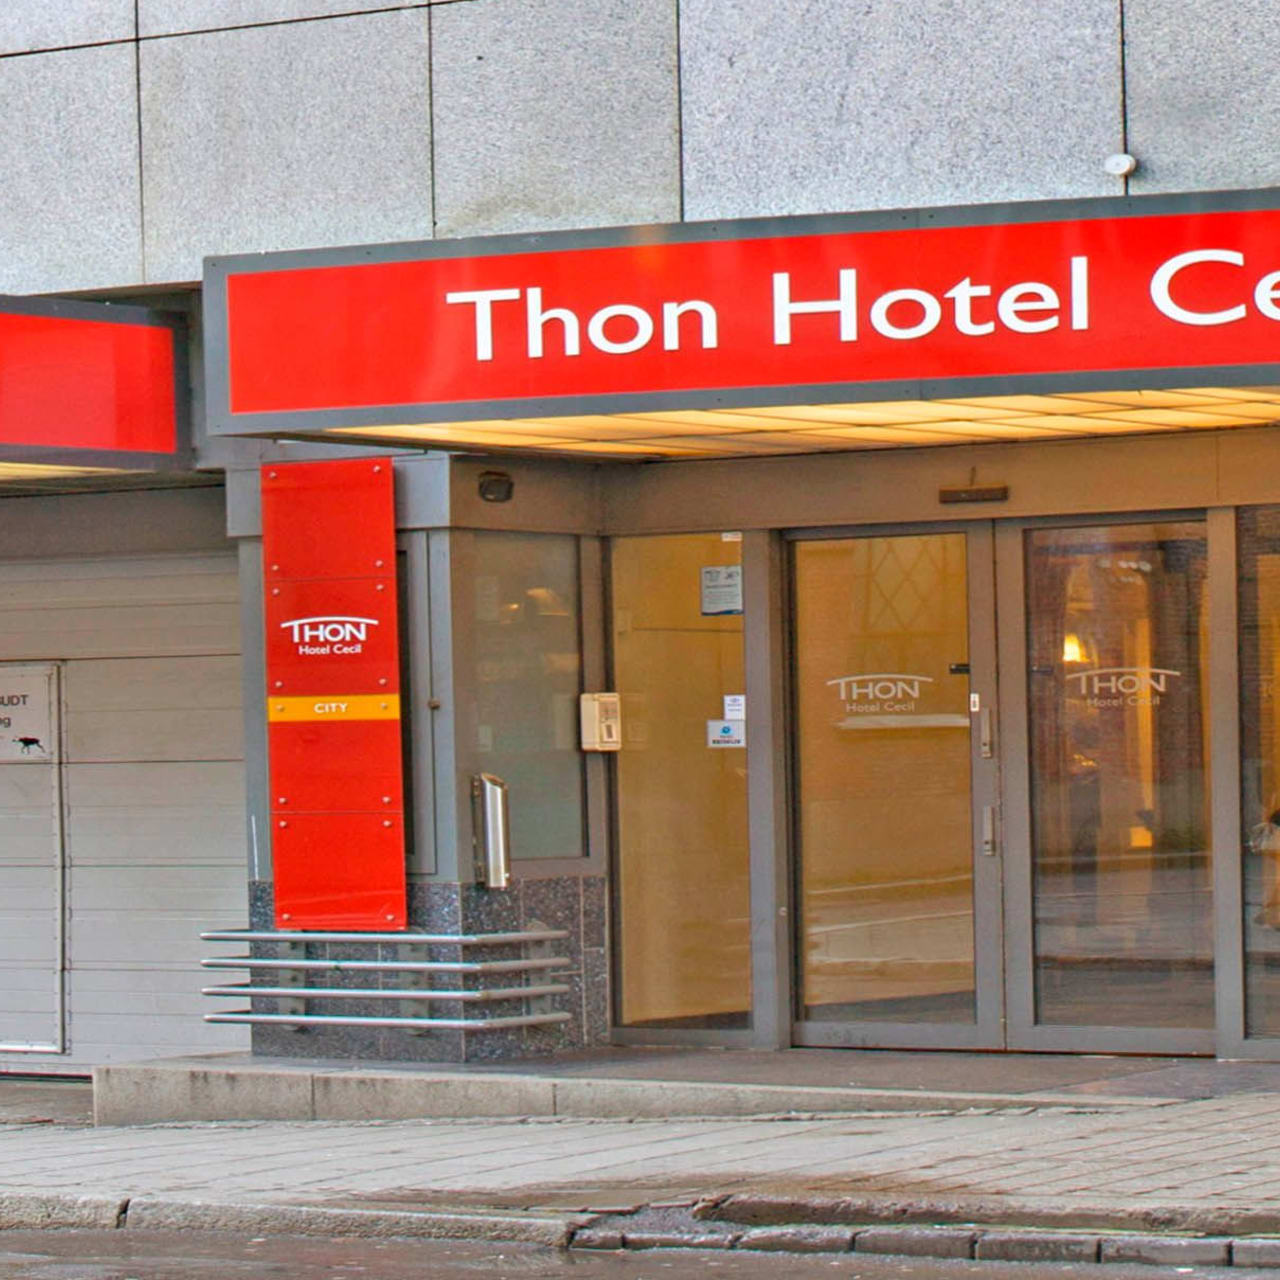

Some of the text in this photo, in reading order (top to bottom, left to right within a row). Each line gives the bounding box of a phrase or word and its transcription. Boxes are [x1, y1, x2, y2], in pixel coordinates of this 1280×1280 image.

[445, 283, 718, 362] Thon
[771, 255, 1090, 345] Hotel
[280, 616, 379, 643] THON
[298, 643, 362, 655] Hotel Cecil
[826, 673, 934, 701] THON
[1065, 667, 1182, 693] THON
[313, 702, 348, 714] CITY
[845, 700, 915, 713] Hotel Cecil
